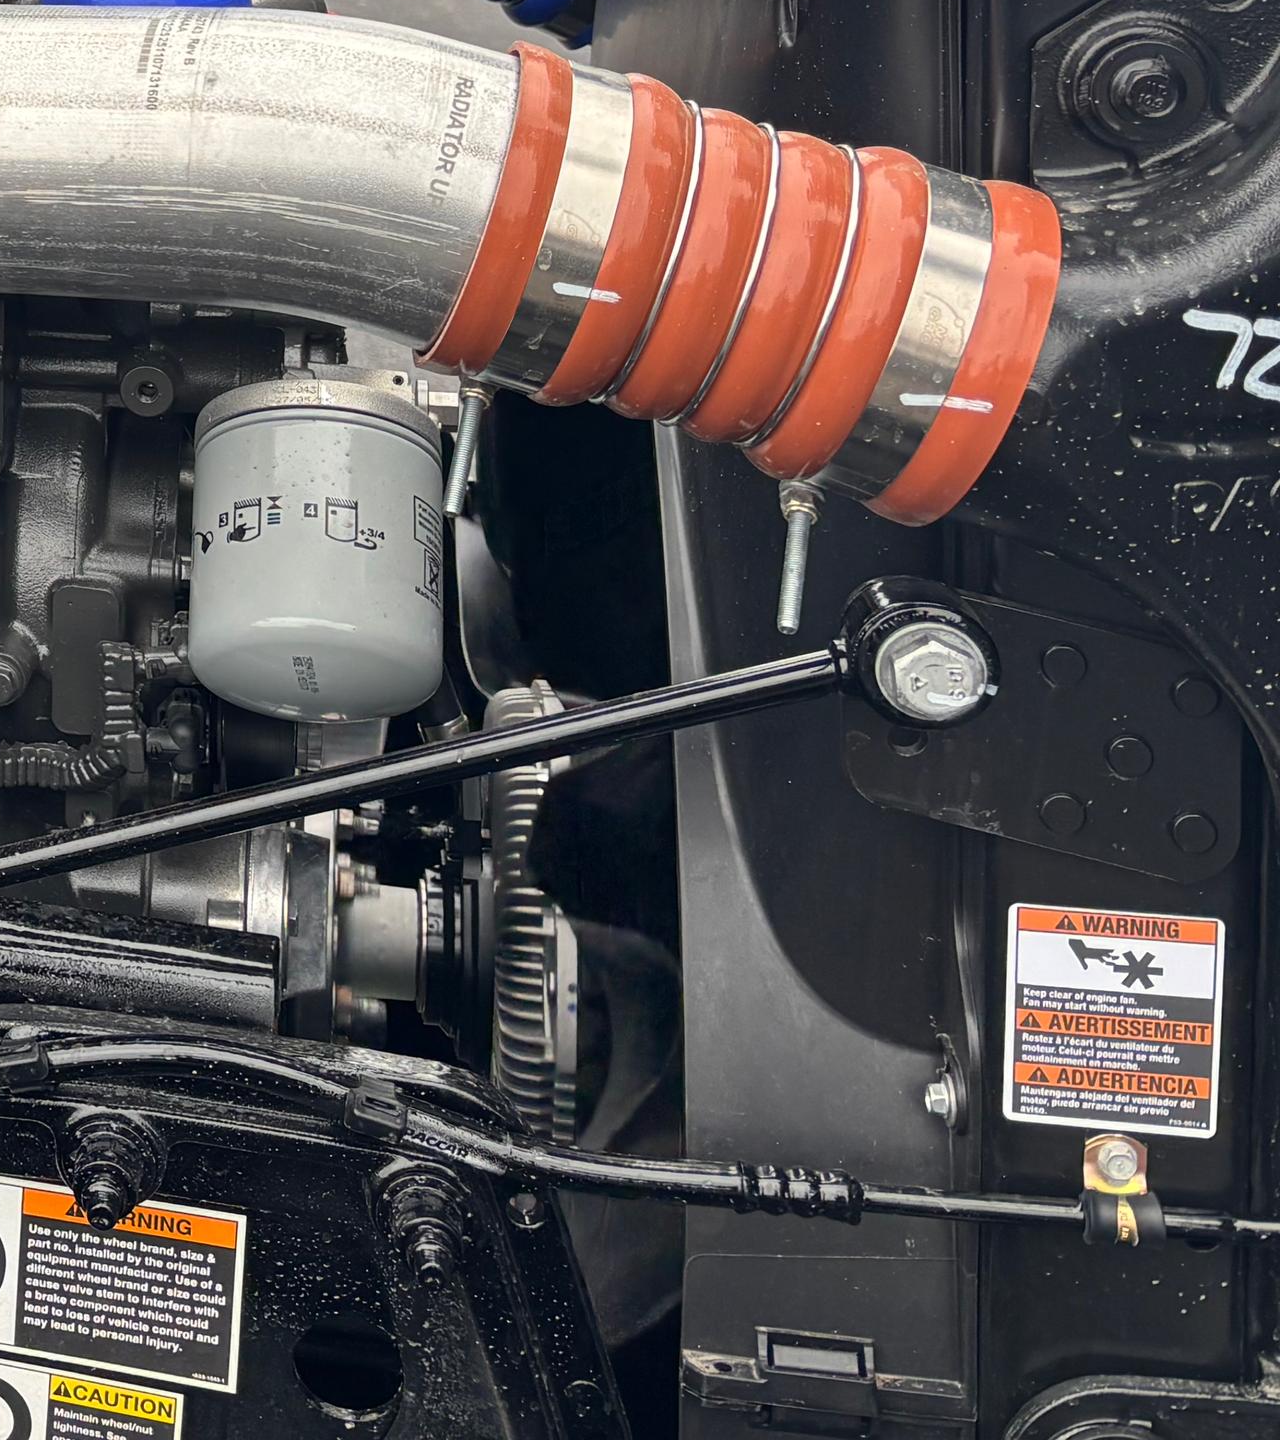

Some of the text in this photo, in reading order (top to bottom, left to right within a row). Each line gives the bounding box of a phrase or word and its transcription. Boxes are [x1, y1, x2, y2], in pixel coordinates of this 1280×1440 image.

[435, 75, 474, 174] RADIATOR
[359, 527, 386, 541] +3/4
[1083, 915, 1179, 939] WARNING
[1023, 988, 1137, 1005] Keep clear of engine fan.
[1023, 999, 1167, 1018] Fan may start without warning.
[1049, 1013, 1209, 1042] AVERTISSEMENT
[1022, 1032, 1174, 1053] Restez à l'écart du ventilateur du
[1022, 1044, 1180, 1064] moteur. Celui-ci pourrait se mettre
[1022, 1054, 1140, 1071] soudainement en marche.
[1057, 1067, 1197, 1095] ADVERTENCIA
[1020, 1106, 1047, 1115] aviso.
[1021, 1085, 1195, 1109] Mantengase alejado del ventilador del
[1021, 1097, 1169, 1116] motor, puede arrancar sin previo
[27, 1237, 211, 1277] part no. installed by the original
[29, 1224, 216, 1263] Use only the wheel brand, size &
[26, 1263, 226, 1306] different wheel brand or size could
[27, 1252, 222, 1292] equipment manufacturer. Use of a
[25, 1278, 219, 1318] cause valve stem to interfere with
[25, 1290, 209, 1329] a brake component which could
[23, 1316, 183, 1353] may lead to personal injury.
[24, 1301, 218, 1344] lead to loss of vehicle control and
[73, 1385, 172, 1418] CAUTION
[53, 1422, 104, 1438] tightness.
[54, 1407, 153, 1435] Maintain wheel/nut
